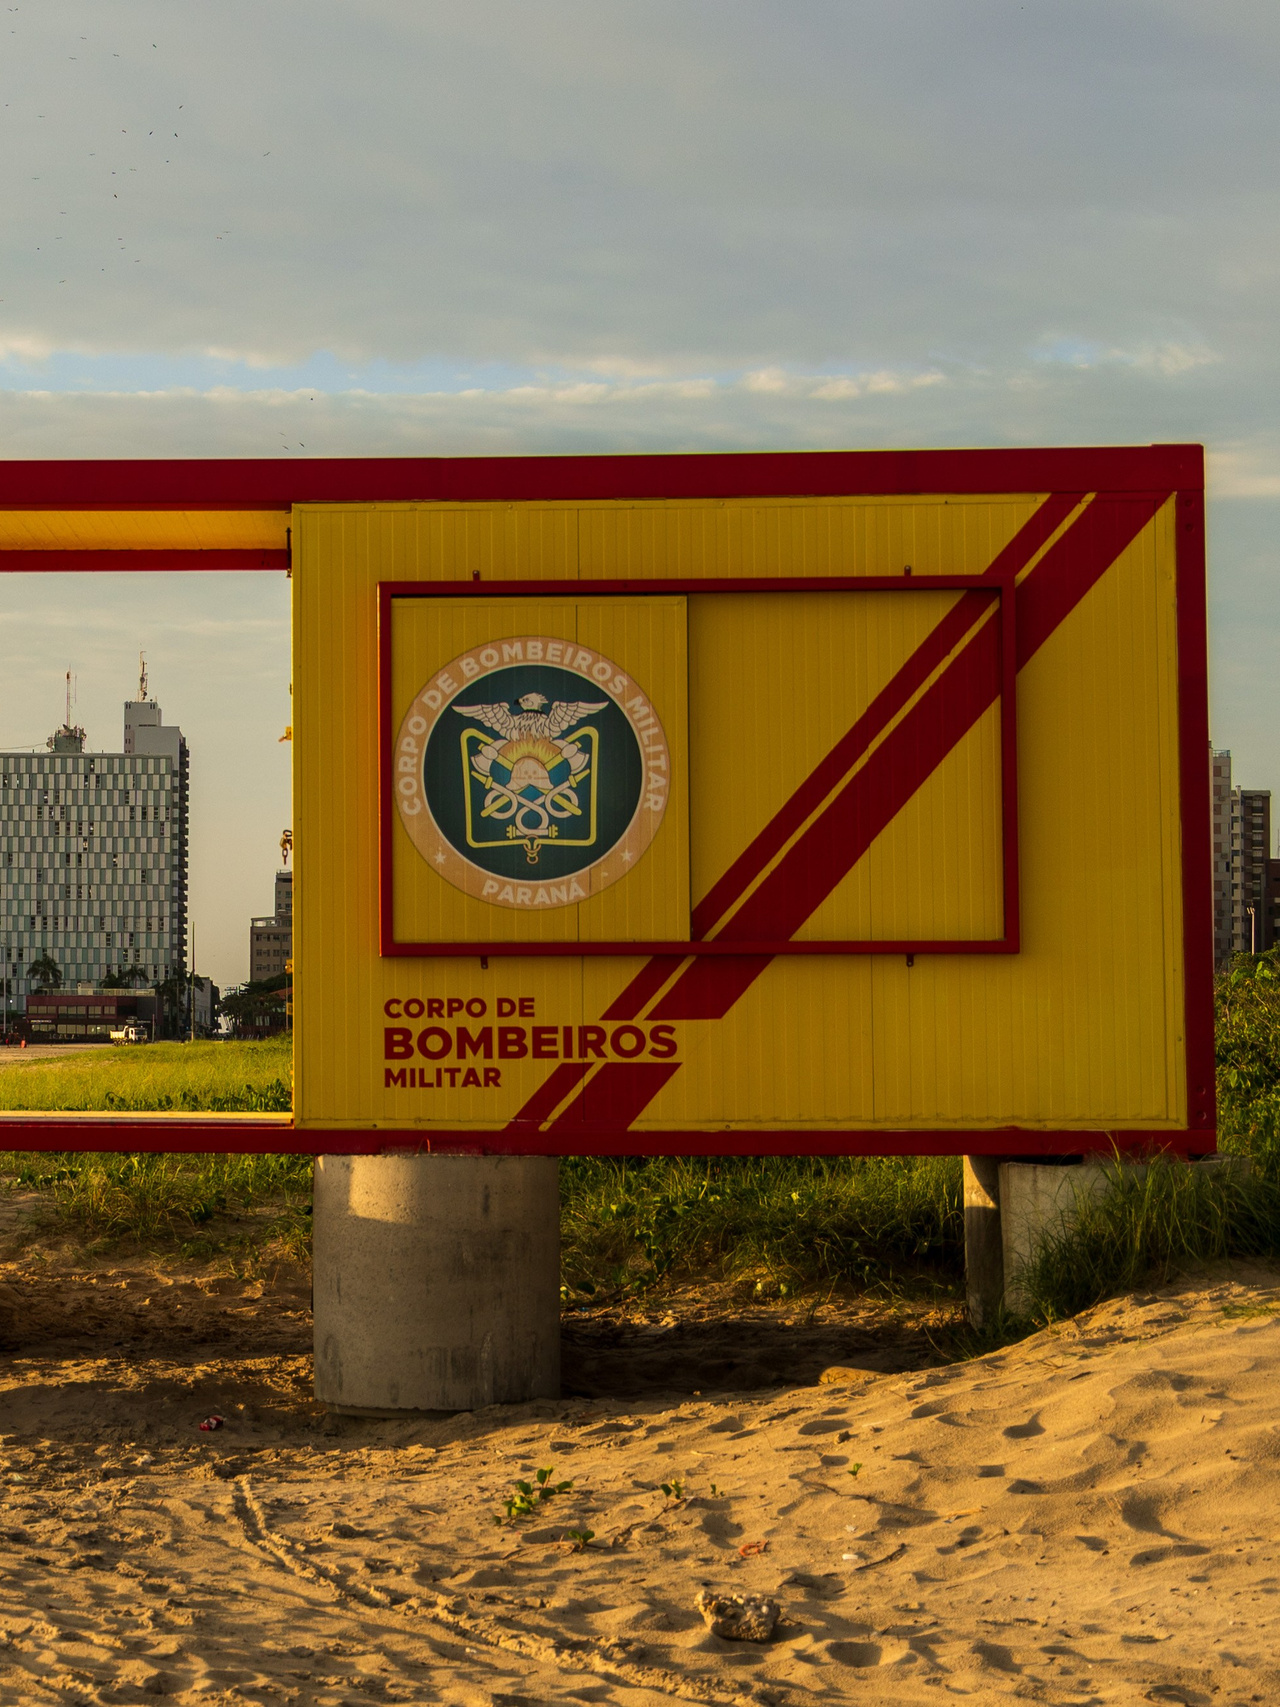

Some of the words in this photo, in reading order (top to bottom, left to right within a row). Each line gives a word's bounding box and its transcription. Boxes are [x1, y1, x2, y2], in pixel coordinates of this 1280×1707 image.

[398, 715, 428, 816] CORPO
[422, 672, 458, 711] DE
[459, 641, 628, 696] BOMBEIROS
[626, 700, 667, 813] MILITAR
[482, 877, 587, 905] PARANÁ
[383, 998, 488, 1019] CORPO
[496, 997, 536, 1018] DE
[384, 1025, 678, 1060] BOMBEIROS
[384, 1067, 502, 1088] MILITAR
